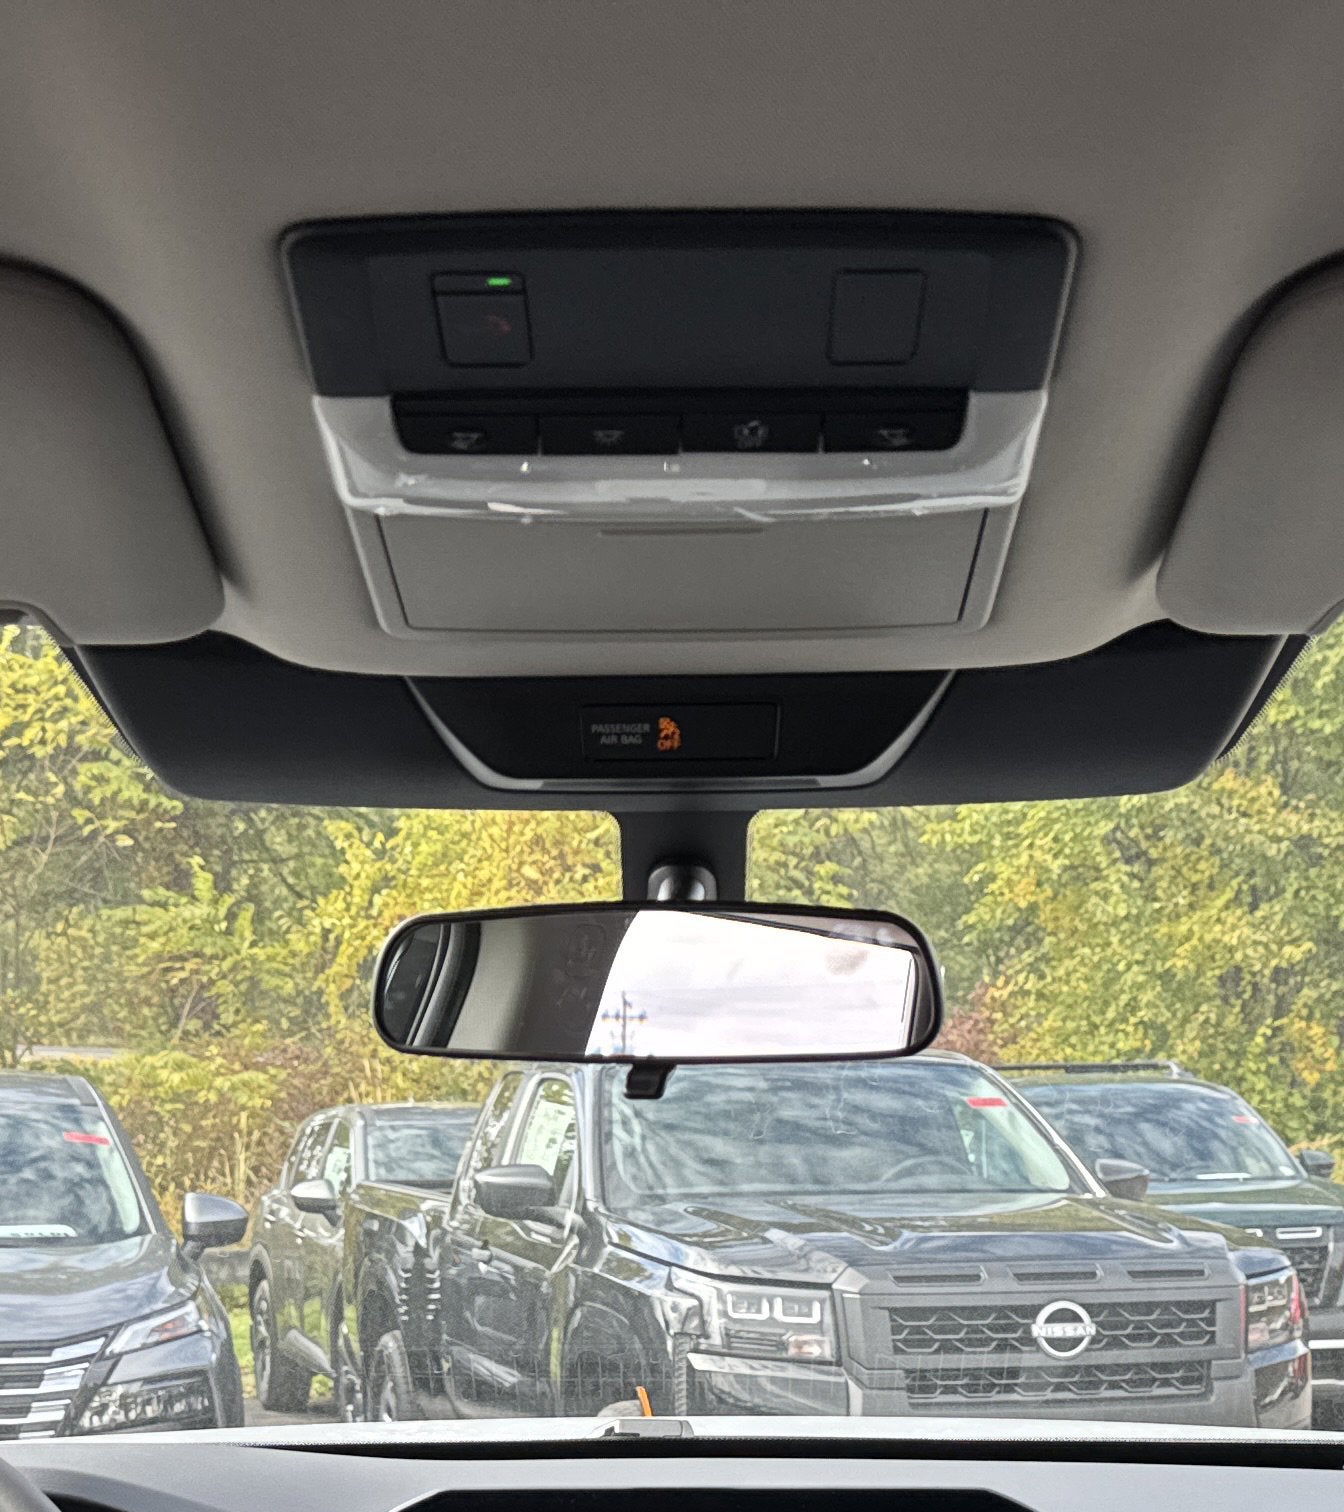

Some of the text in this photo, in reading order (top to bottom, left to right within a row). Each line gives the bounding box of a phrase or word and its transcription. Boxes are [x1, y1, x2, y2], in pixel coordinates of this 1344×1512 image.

[591, 723, 651, 733] PASSENGER
[600, 734, 643, 744] AIR BAG
[1032, 1325, 1096, 1337] NISSAN
